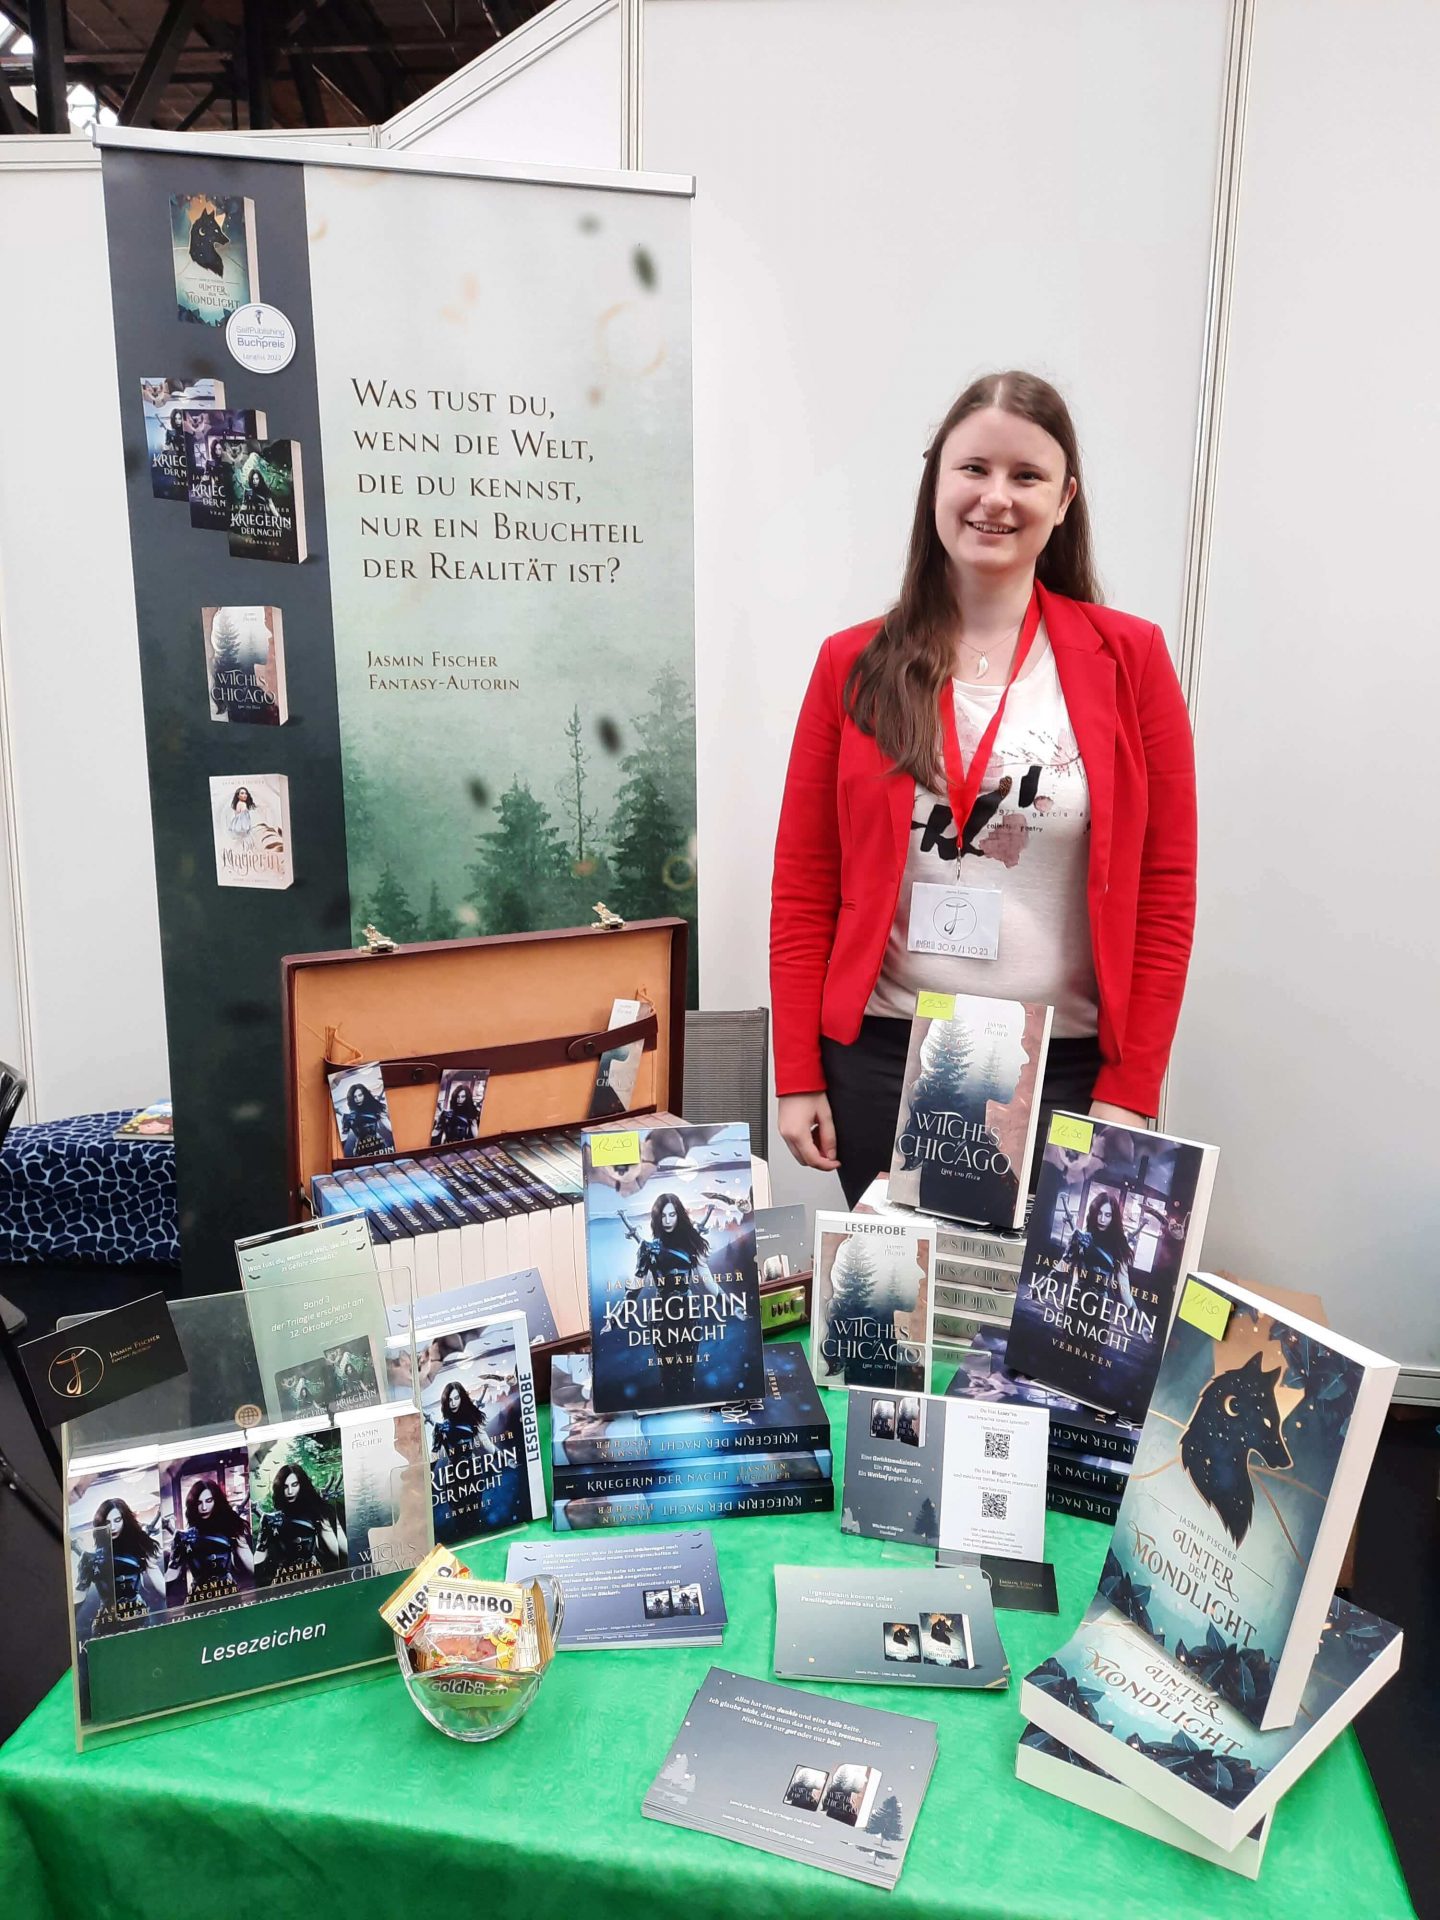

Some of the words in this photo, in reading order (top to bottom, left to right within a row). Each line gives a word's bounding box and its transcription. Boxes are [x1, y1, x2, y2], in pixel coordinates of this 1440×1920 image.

[186, 291, 239, 309] MONDLICHT
[237, 338, 285, 349] Buchpreis
[351, 378, 417, 410] WAS
[427, 389, 496, 412] TUST
[509, 394, 555, 420] DU,
[354, 430, 440, 453] WENN
[455, 434, 500, 455] DIE
[511, 429, 594, 463] WELT,
[357, 473, 404, 494] DIE
[417, 475, 455, 496] DU
[470, 477, 581, 504] KENNST,
[230, 513, 291, 530] KRIEGERIN
[361, 516, 422, 537] NUR
[434, 518, 479, 538] EIN
[494, 512, 644, 543] BRUCHTEIL
[241, 527, 257, 536] DER
[257, 528, 282, 537] NACHT
[363, 558, 418, 579] DER
[430, 552, 557, 581] REALITÄT
[569, 557, 621, 583] IST?
[367, 651, 424, 668] JASMIN
[432, 651, 498, 667] FISCHER
[369, 674, 520, 690] FANTASY-AUTORIN
[211, 687, 275, 704] CHICAGO
[223, 848, 280, 876] Magierin
[916, 1110, 1002, 1146] WITCHES
[898, 1133, 1012, 1175] CHICAGO
[845, 1223, 907, 1236] LESEPROBE
[606, 1277, 666, 1292] JASMIN
[1036, 1254, 1089, 1279] JASMIN
[1095, 1274, 1160, 1305] FISHER
[303, 1296, 324, 1310] Band
[324, 1295, 330, 1303] 3
[1028, 1272, 1158, 1339] KRIEGERIN
[271, 1322, 285, 1332] der
[286, 1312, 315, 1327] Trilogie
[316, 1300, 351, 1318] erscheint
[351, 1297, 364, 1307] am
[302, 1320, 333, 1334] Oktober
[334, 1312, 353, 1324] 2023
[601, 1292, 748, 1334] KRIEGERIN
[629, 1330, 667, 1347] DER
[667, 1324, 727, 1344] NACHT
[833, 1316, 910, 1340] WITCHES
[1043, 1307, 1075, 1336] DER
[1077, 1320, 1132, 1352] NACHT
[109, 1346, 132, 1359] JASMIN
[134, 1334, 161, 1348] FISCHER
[821, 1339, 922, 1364] CHICAGO
[1052, 1338, 1113, 1368] VERRATEN
[648, 1353, 711, 1367] ERWÄHLT
[519, 1371, 540, 1463] LESEPROBE
[354, 1429, 379, 1440] JASMIN
[595, 1439, 652, 1450] FISCHER
[660, 1438, 701, 1451] NACHT
[706, 1437, 730, 1449] DER
[734, 1432, 799, 1447] KRIEGERIN
[1053, 1428, 1088, 1445] NACH
[1092, 1435, 1118, 1451] DER
[601, 1447, 649, 1459] JASMIN
[431, 1446, 518, 1491] RIEGERIN
[735, 1471, 791, 1483] FISCHER
[739, 1463, 788, 1473] JASMIN
[1065, 1466, 1109, 1485] NACHT
[432, 1489, 458, 1507] DER
[458, 1474, 503, 1498] NACHT
[587, 1476, 653, 1492] KRIEGERIN
[658, 1473, 684, 1486] DER
[687, 1470, 729, 1483] NACHT
[445, 1498, 492, 1519] ERWÄHLT
[598, 1504, 654, 1515] FISCHER
[662, 1503, 705, 1516] NACHT
[709, 1501, 733, 1513] DER
[737, 1495, 802, 1510] KRIEGERIN
[1046, 1493, 1082, 1509] NACH
[1085, 1500, 1111, 1516] DER
[602, 1512, 650, 1524] JASMIN
[1180, 1515, 1205, 1538] JASMIN
[1206, 1535, 1238, 1562] FISCHER
[276, 1561, 318, 1577] JASMIN
[1172, 1529, 1239, 1603] UNTER
[1188, 1562, 1207, 1583] DEM
[272, 1568, 322, 1585] FISCHER
[1128, 1520, 1257, 1648] MONDLICHT
[186, 1586, 238, 1603] FISCHER
[188, 1579, 235, 1595] JASMIN
[97, 1600, 143, 1617] JASMIN
[437, 1591, 514, 1614] HARIBO
[525, 1596, 536, 1627] HARIBO
[201, 1621, 327, 1666] Lesezeichen
[430, 1679, 508, 1696] Goldbären
[1145, 1665, 1223, 1726] UNTER
[1160, 1688, 1184, 1705] DEM
[1083, 1646, 1244, 1756] MONDLICHT
[709, 1697, 720, 1705] Ich
[719, 1700, 742, 1711] glaube
[742, 1706, 760, 1717] nicht,
[760, 1711, 776, 1721] dass
[776, 1715, 791, 1724] man
[791, 1718, 804, 1728] das
[812, 1725, 838, 1737] einfach
[838, 1731, 863, 1744] trennen
[863, 1736, 883, 1747] kann.
[735, 1695, 751, 1705] Alles
[751, 1700, 762, 1708] hat
[762, 1704, 777, 1712] eine
[777, 1706, 799, 1718] dunkle
[799, 1713, 812, 1721] und
[812, 1716, 827, 1725] eine
[827, 1719, 843, 1729] helle
[843, 1723, 862, 1734] Seite.
[741, 1715, 763, 1727] Nichts
[763, 1720, 773, 1729] ist
[773, 1724, 785, 1733] nur
[784, 1727, 798, 1736] gut
[797, 1730, 813, 1740] oder
[813, 1735, 827, 1743] nur
